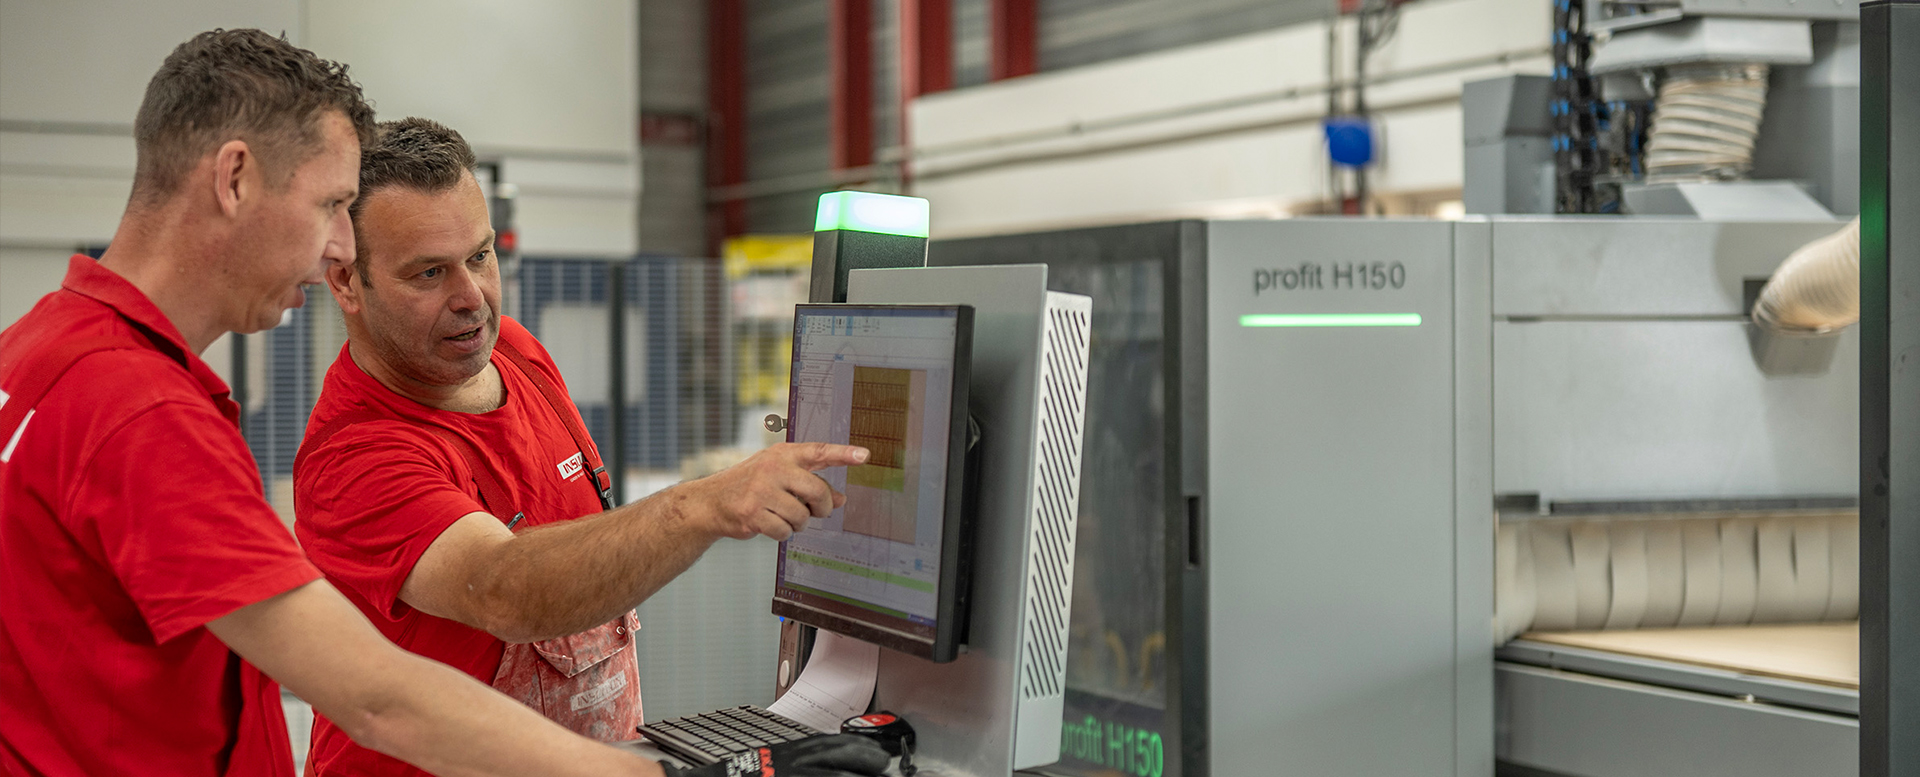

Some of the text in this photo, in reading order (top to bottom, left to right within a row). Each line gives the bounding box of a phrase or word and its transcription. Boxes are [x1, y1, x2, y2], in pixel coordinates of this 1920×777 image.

[1254, 260, 1406, 296] profit H150
[1106, 721, 1163, 777] H150
